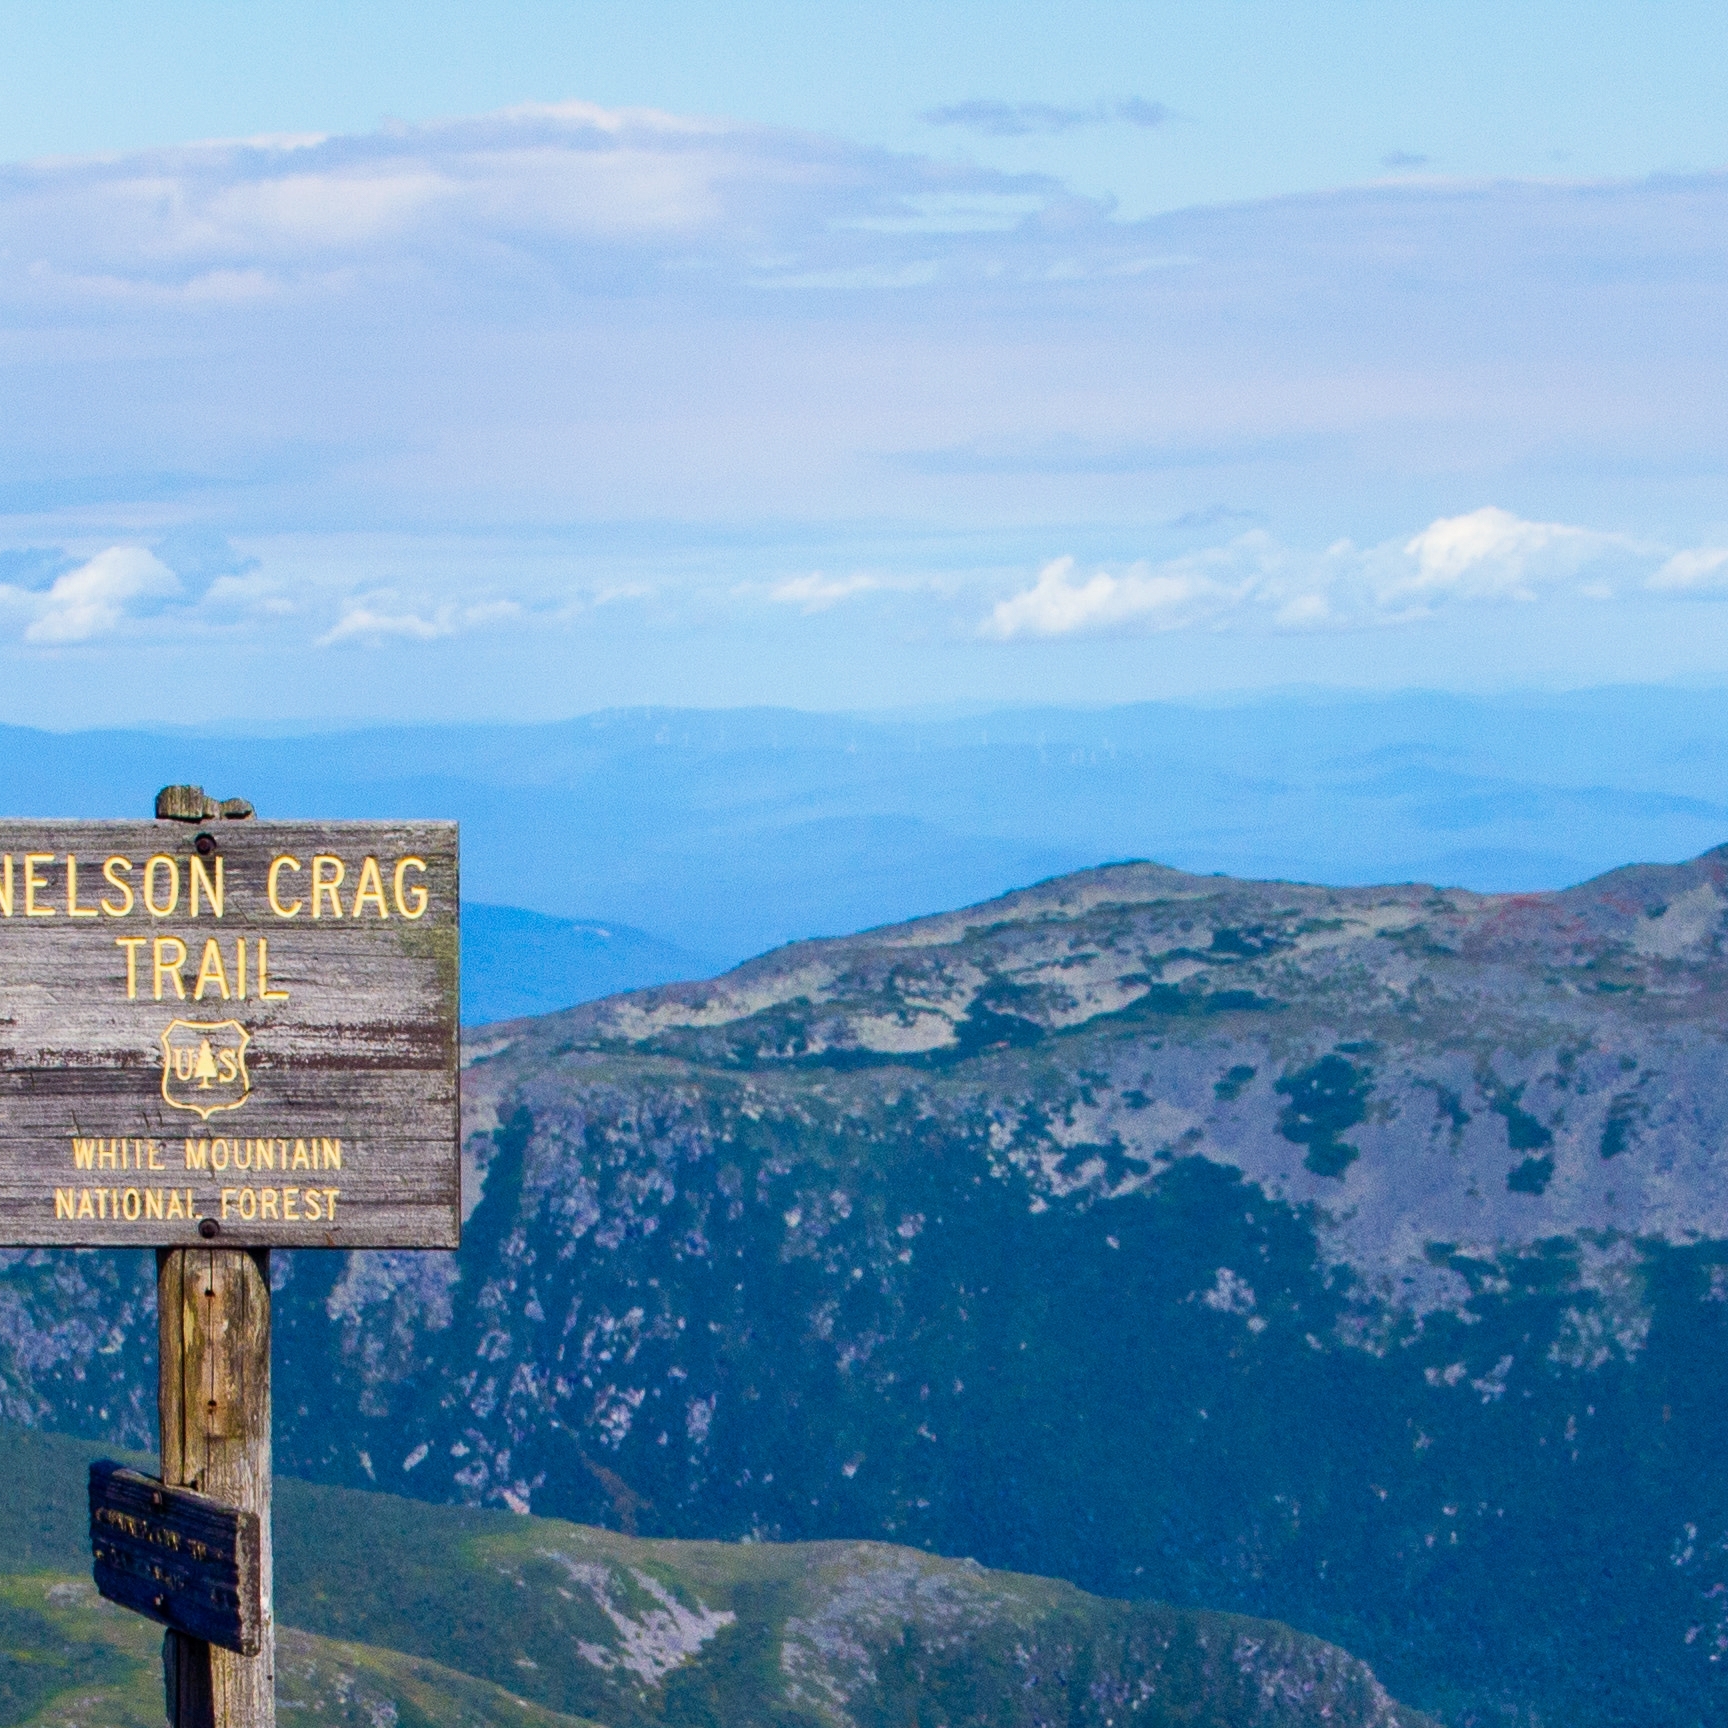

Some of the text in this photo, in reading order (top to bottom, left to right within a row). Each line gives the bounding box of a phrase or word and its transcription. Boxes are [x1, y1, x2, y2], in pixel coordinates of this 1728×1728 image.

[266, 853, 429, 919] CRAG
[115, 935, 290, 1000] TRAIL
[73, 1138, 342, 1170] WHITE MOUNTAIN
[54, 1186, 340, 1220] NATIONAL FOREST
